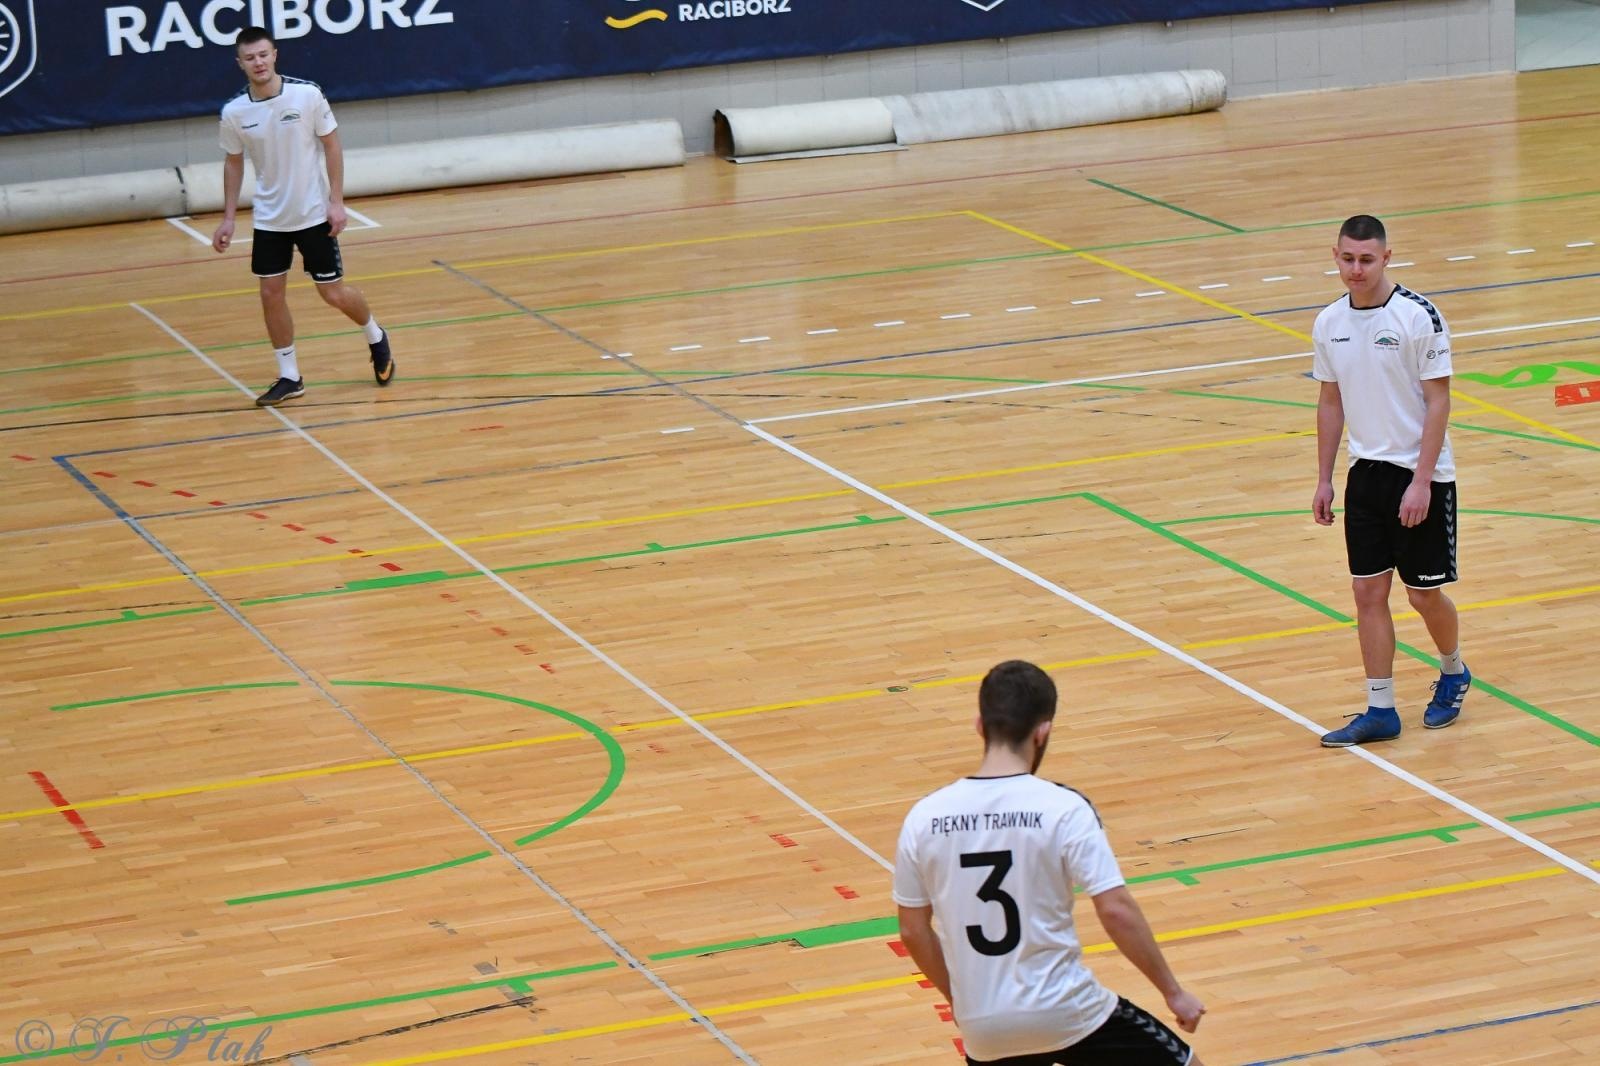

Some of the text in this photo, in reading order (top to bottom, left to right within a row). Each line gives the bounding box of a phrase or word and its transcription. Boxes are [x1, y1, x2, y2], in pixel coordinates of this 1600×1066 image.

[931, 811, 1043, 837] PIĘKNY TRAWNIK
[959, 849, 1021, 957] 3
